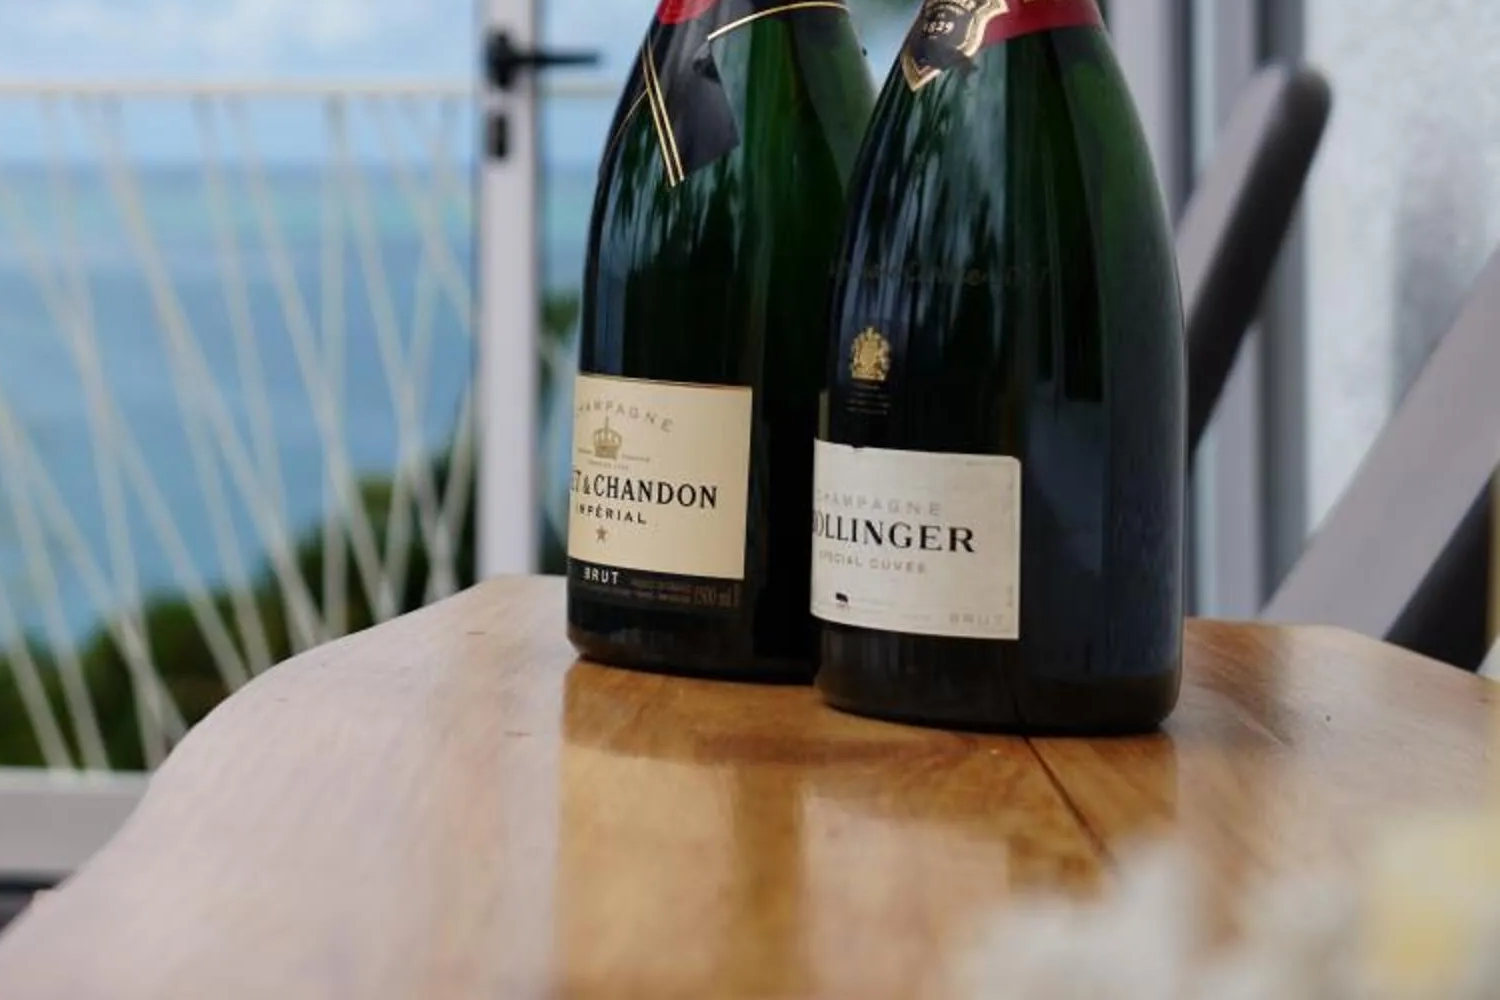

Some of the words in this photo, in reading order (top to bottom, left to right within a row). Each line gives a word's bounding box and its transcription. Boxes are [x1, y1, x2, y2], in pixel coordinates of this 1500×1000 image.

[593, 473, 718, 510] CHANDON
[813, 509, 976, 554] OLLINGER
[583, 566, 621, 586] BRUT
